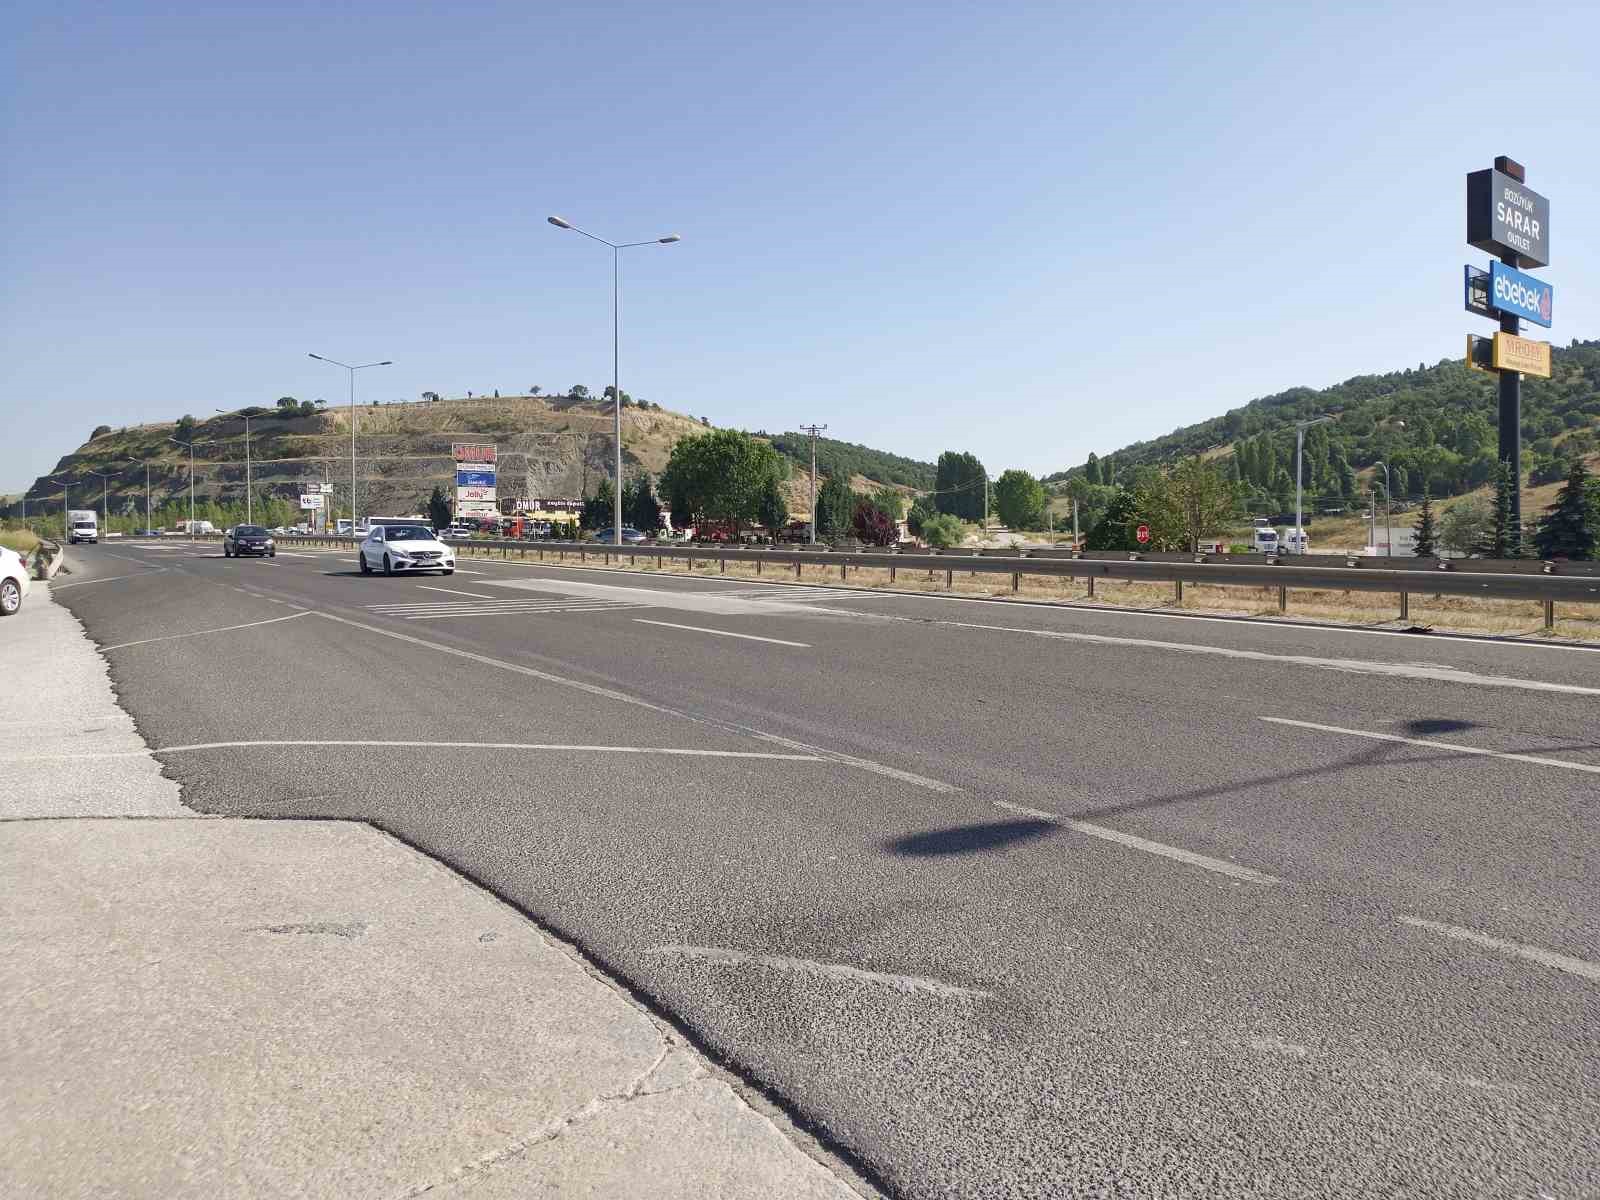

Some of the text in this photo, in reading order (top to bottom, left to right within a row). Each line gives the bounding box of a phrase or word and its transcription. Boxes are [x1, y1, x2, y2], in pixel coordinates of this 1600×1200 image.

[1497, 202, 1540, 240] SARAR
[1507, 231, 1530, 250] OUTLET
[1495, 275, 1541, 312] ebebek
